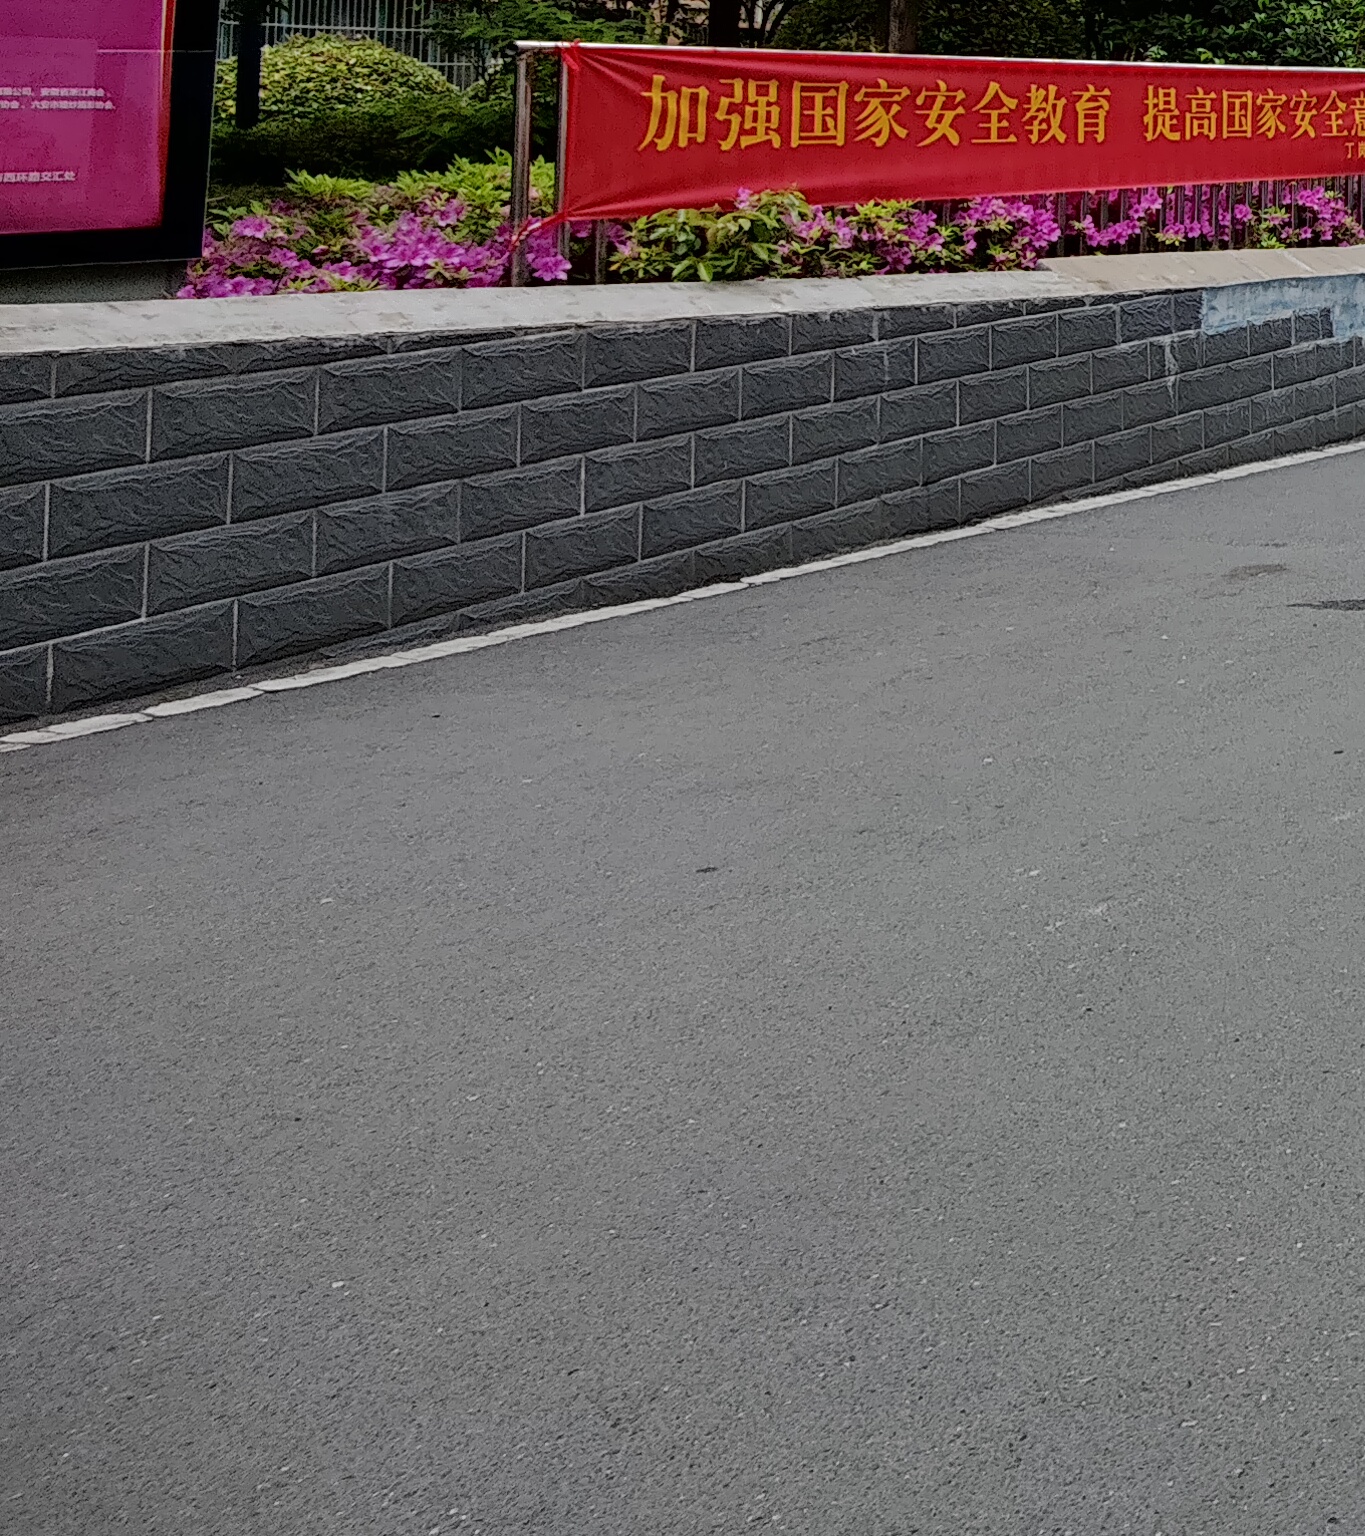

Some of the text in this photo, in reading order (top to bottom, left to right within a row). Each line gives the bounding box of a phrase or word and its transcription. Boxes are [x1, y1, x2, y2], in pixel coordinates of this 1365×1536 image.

[638, 73, 1112, 152] 加强国家安全教育
